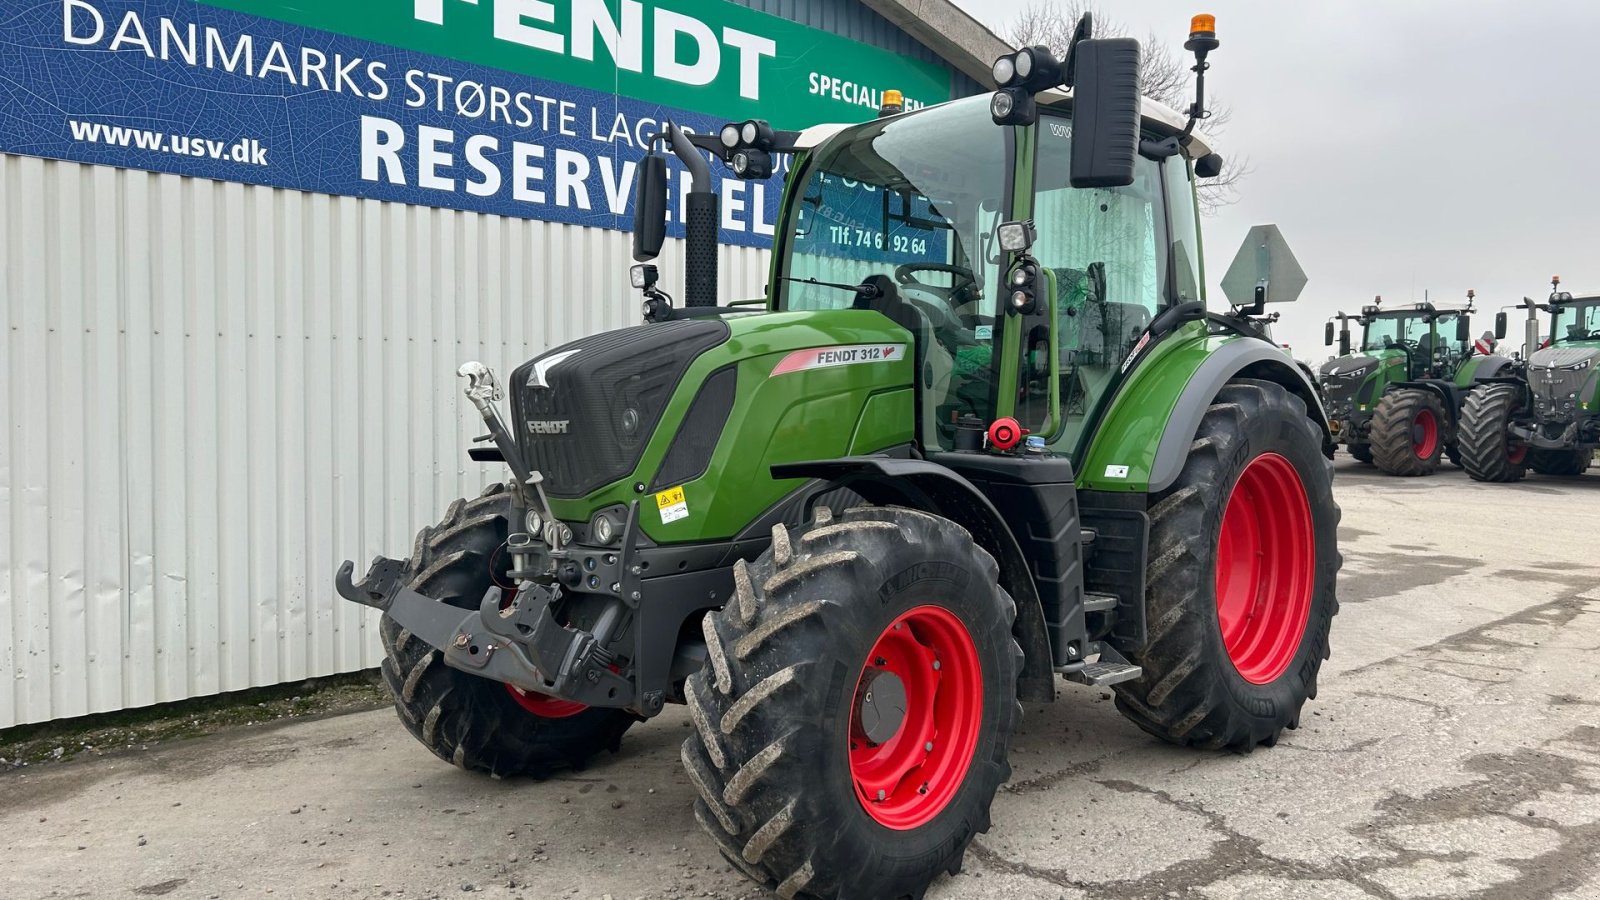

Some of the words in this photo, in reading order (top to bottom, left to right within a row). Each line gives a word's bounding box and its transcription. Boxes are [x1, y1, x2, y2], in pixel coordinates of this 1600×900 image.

[63, 0, 389, 100] DANMARKS
[405, 69, 577, 137] STØRSTE
[414, 0, 776, 101] ENDT
[69, 119, 269, 166] www.usv.dk
[829, 225, 852, 246] Tlf.
[855, 229, 871, 248] 74
[874, 232, 890, 250] 6
[893, 234, 909, 253] 92
[911, 237, 927, 256] 64
[817, 349, 858, 364] FENDT
[860, 347, 880, 360] 312
[526, 419, 570, 434] FENDT
